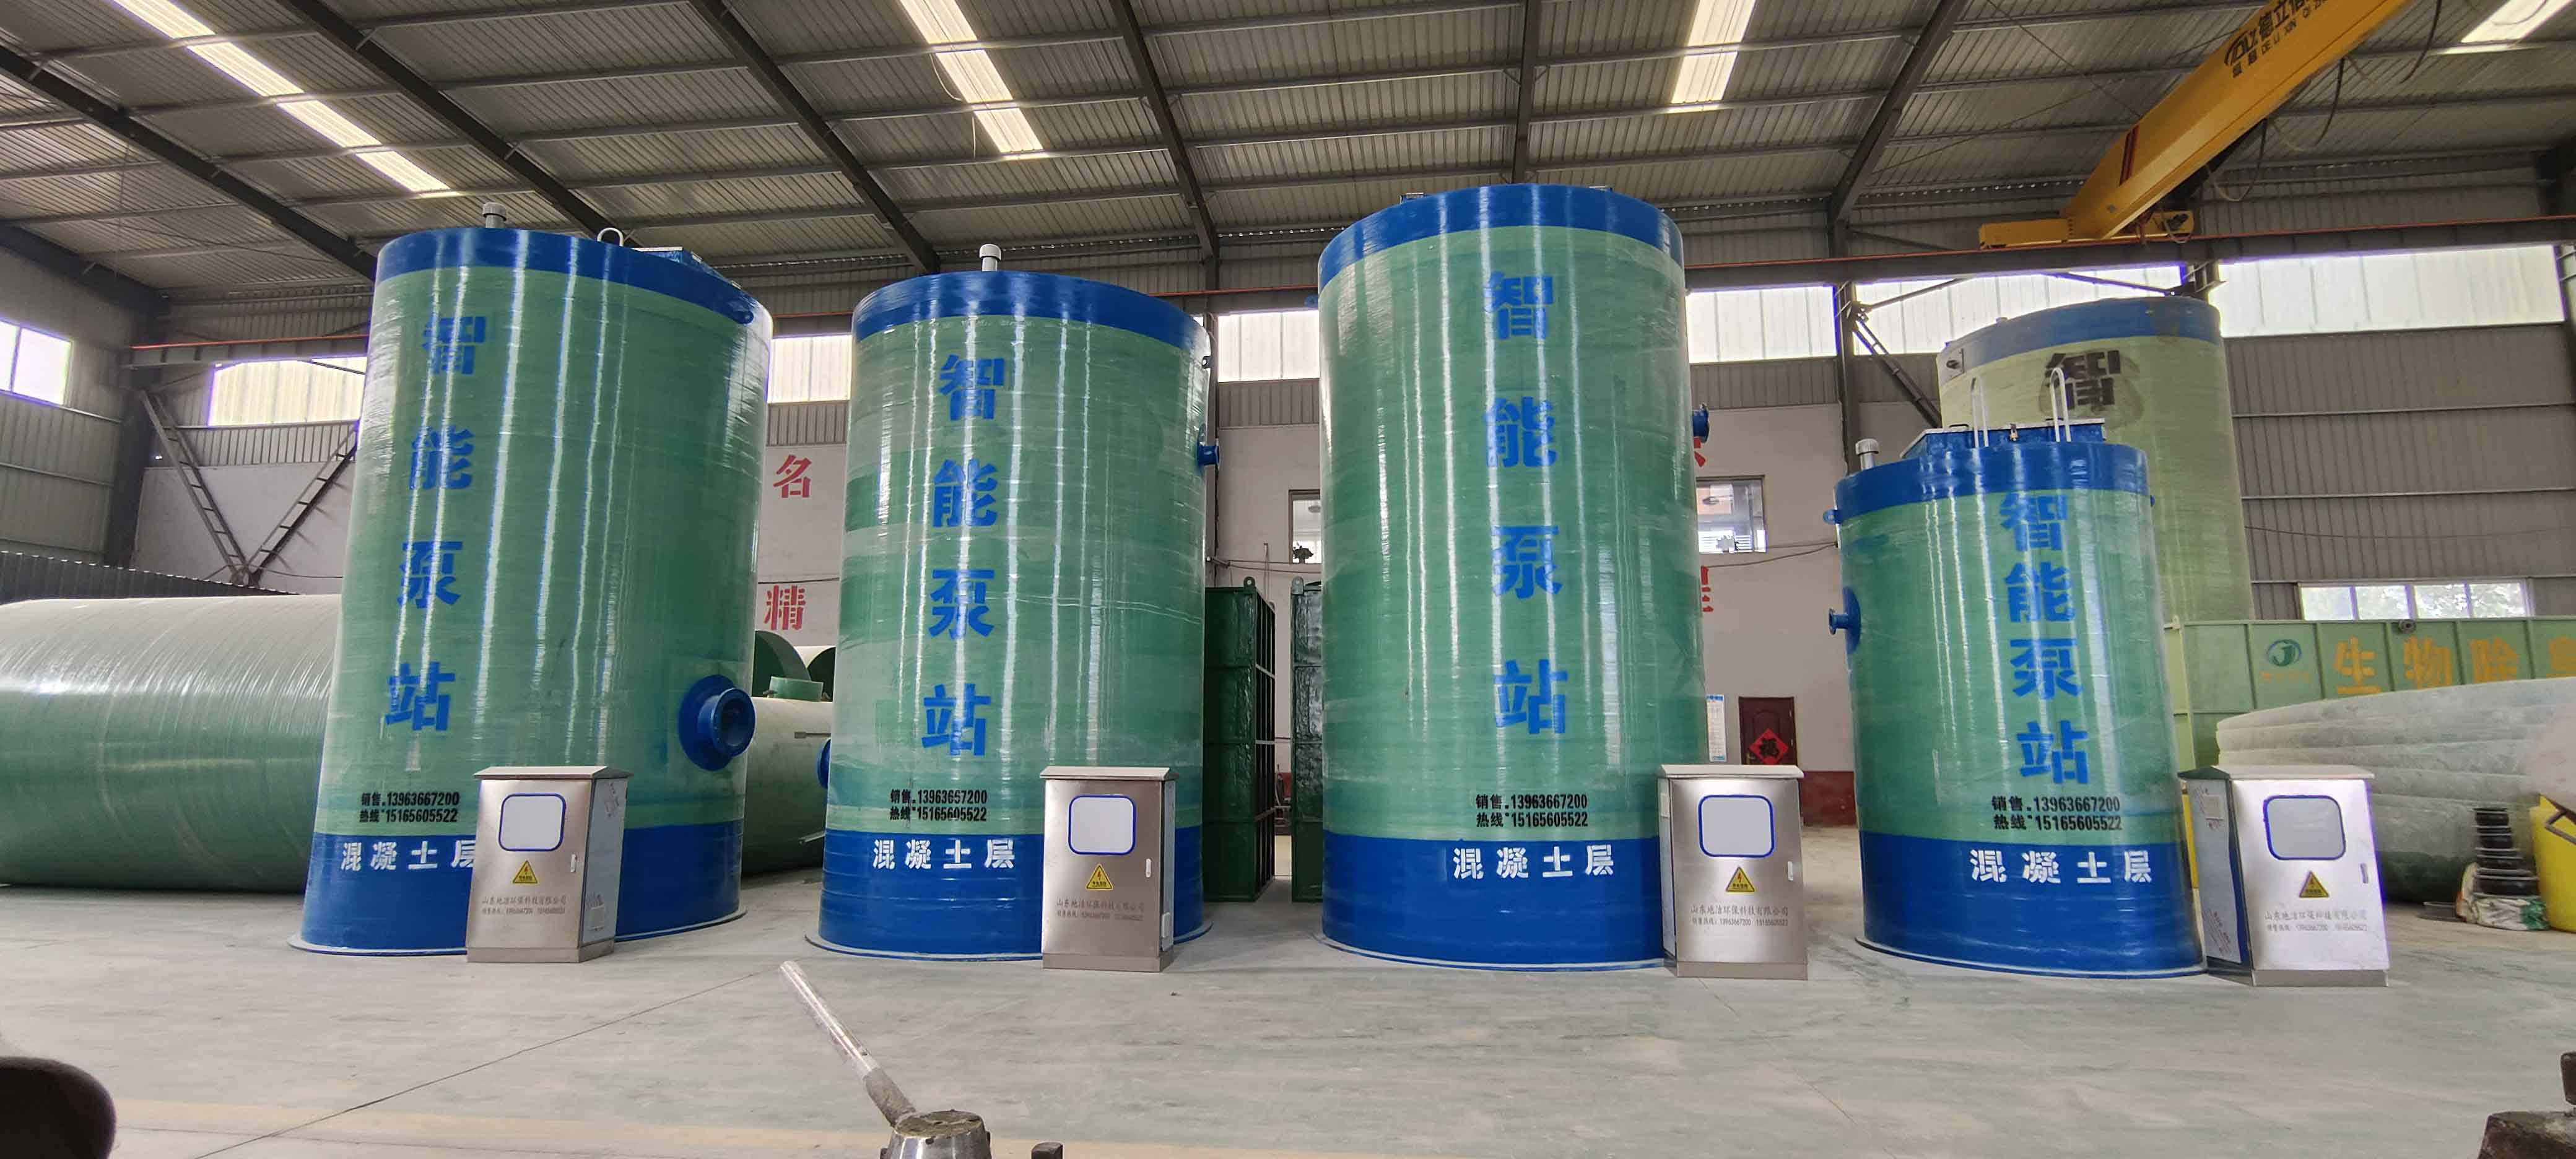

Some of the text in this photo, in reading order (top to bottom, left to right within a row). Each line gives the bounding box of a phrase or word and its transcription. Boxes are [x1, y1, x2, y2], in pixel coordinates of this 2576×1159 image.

[2045, 349, 2120, 411] 智
[773, 454, 812, 498] 名
[386, 315, 487, 731] 智能泵站
[1482, 272, 1568, 734] 智能泵站
[922, 354, 1005, 760] 智能泵站
[764, 584, 806, 630] 精
[1999, 493, 2089, 784] 智能泵站
[341, 840, 476, 871] 混凝土层
[872, 839, 1015, 869] 混凝土层
[1453, 844, 1614, 879] 混凝土层
[1970, 849, 2152, 883] 混凝土层
